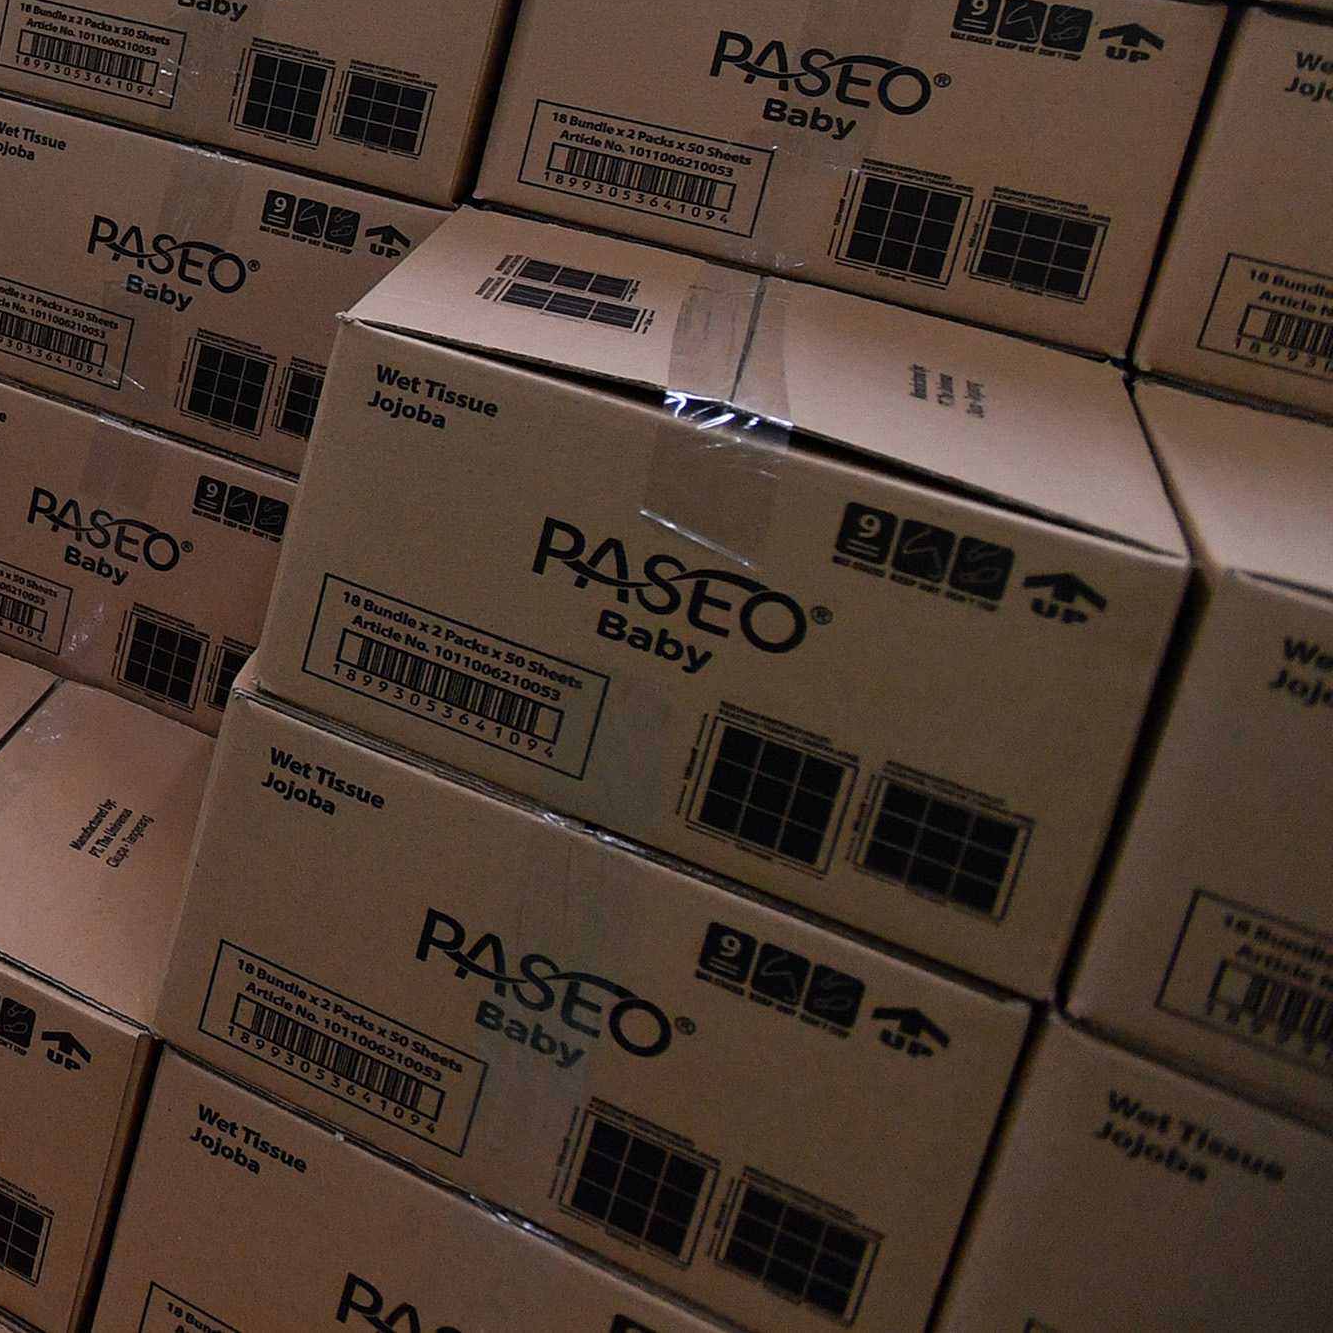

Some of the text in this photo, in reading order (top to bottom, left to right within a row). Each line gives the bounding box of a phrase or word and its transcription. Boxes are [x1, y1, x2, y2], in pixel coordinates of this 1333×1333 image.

[1104, 44, 1151, 64] UP
[21, 127, 67, 152] Tissue
[761, 97, 857, 141] Baby
[273, 196, 288, 213] 9
[368, 242, 402, 260] UP
[124, 273, 194, 313] Baby
[366, 390, 447, 430] Jojoba
[376, 363, 499, 418] Wet Tissue
[205, 483, 219, 500] 9
[858, 514, 882, 539] 9
[63, 545, 130, 587] Baby
[1030, 597, 1090, 626] UP
[342, 591, 362, 608] 18
[362, 597, 418, 629] Bundle
[430, 623, 443, 639] 2
[443, 628, 490, 656] Packs
[503, 651, 527, 669] 50
[526, 659, 584, 691] Sheets
[350, 614, 562, 703] Article No. 1011006210053
[595, 608, 714, 675] Baby
[260, 771, 336, 816] Jojoba
[269, 746, 386, 810] Wet Tissue
[720, 935, 743, 959] 9
[237, 958, 255, 976] 18
[255, 966, 308, 1001] Bundle
[319, 997, 332, 1012] 2
[332, 1002, 376, 1033] Packs
[387, 1030, 410, 1048] 50
[410, 1040, 464, 1074] Sheets
[244, 981, 443, 1083] Article No. 1011006210053
[474, 999, 585, 1069] Baby
[45, 1047, 82, 1072] UP
[879, 1028, 934, 1059] UP
[189, 1126, 261, 1175] Jojoba
[198, 1102, 308, 1174] Wet Tissue
